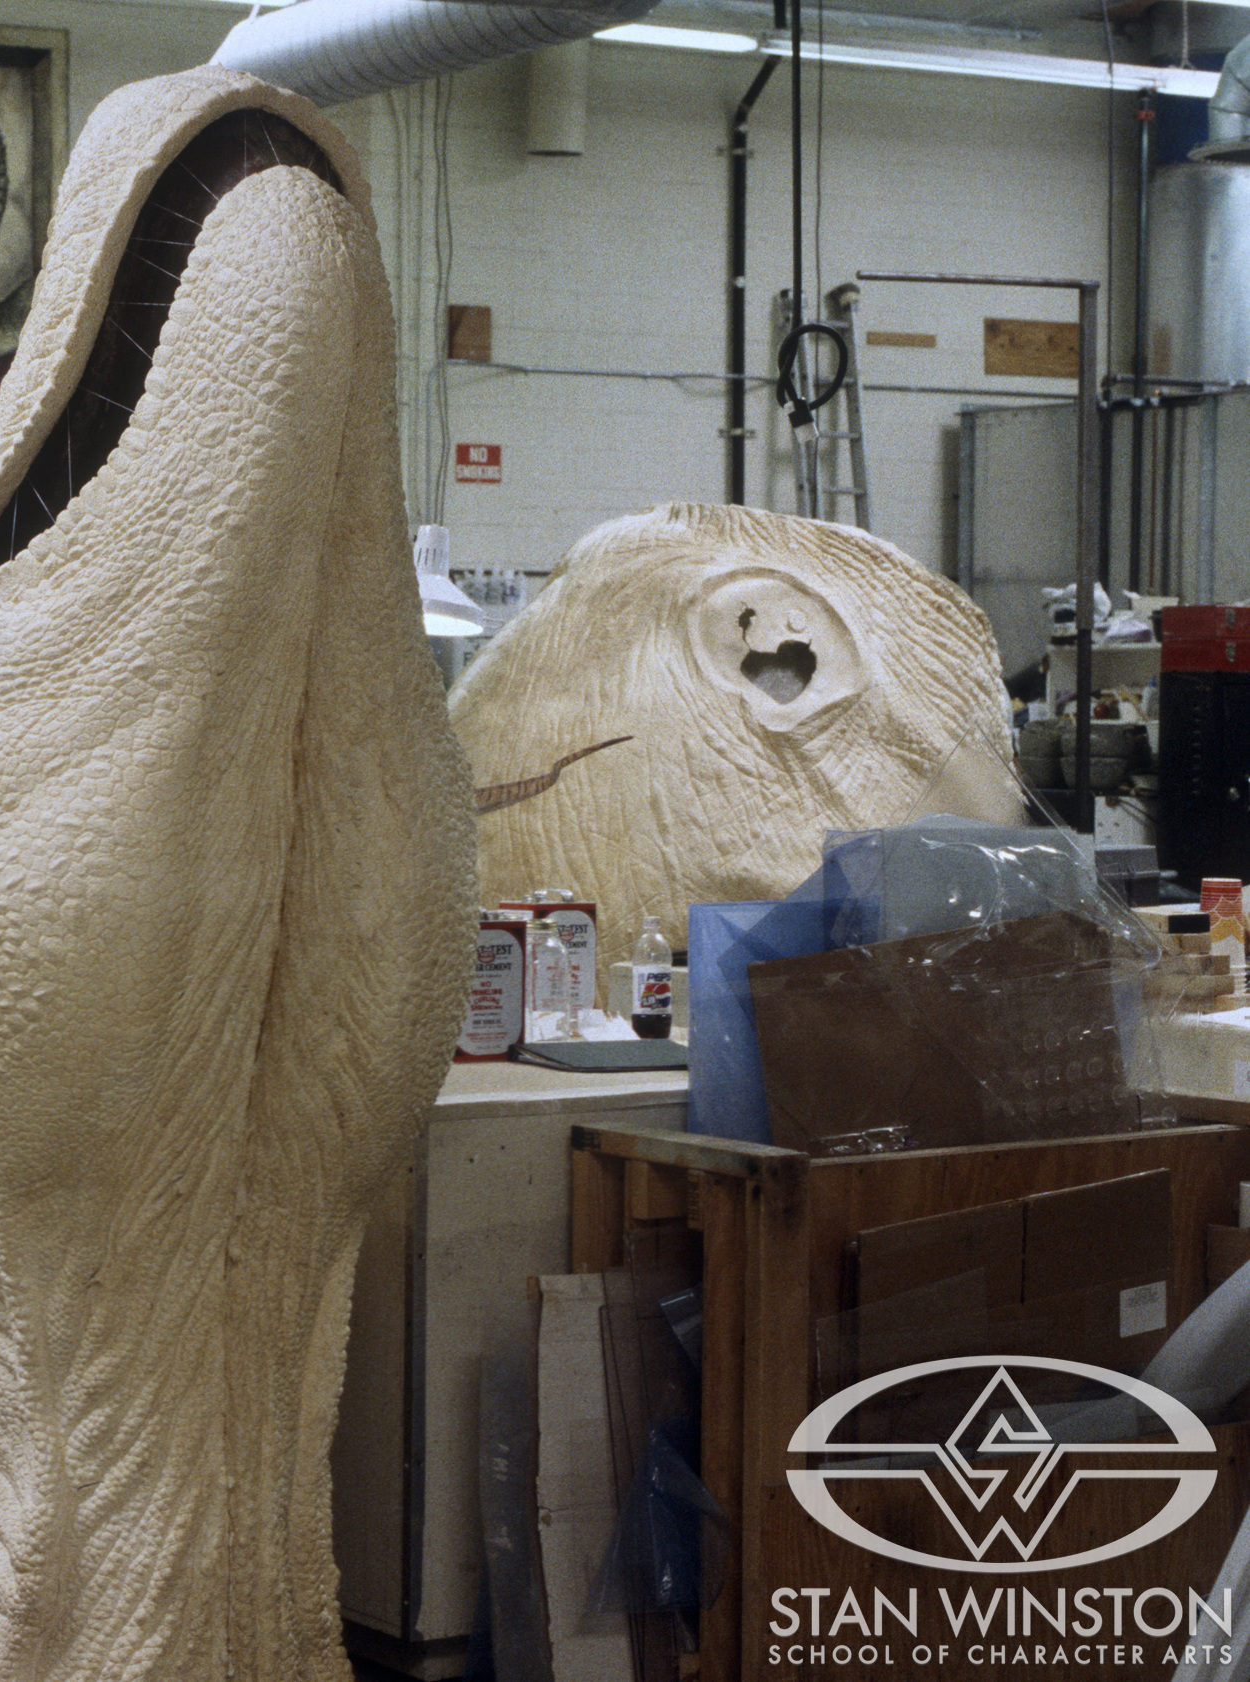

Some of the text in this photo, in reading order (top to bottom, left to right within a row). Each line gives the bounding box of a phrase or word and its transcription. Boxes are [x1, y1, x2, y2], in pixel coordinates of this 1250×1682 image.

[469, 447, 488, 463] NO
[456, 465, 502, 479] SMOKING
[485, 962, 512, 972] CEMENT
[646, 972, 671, 982] PEPS
